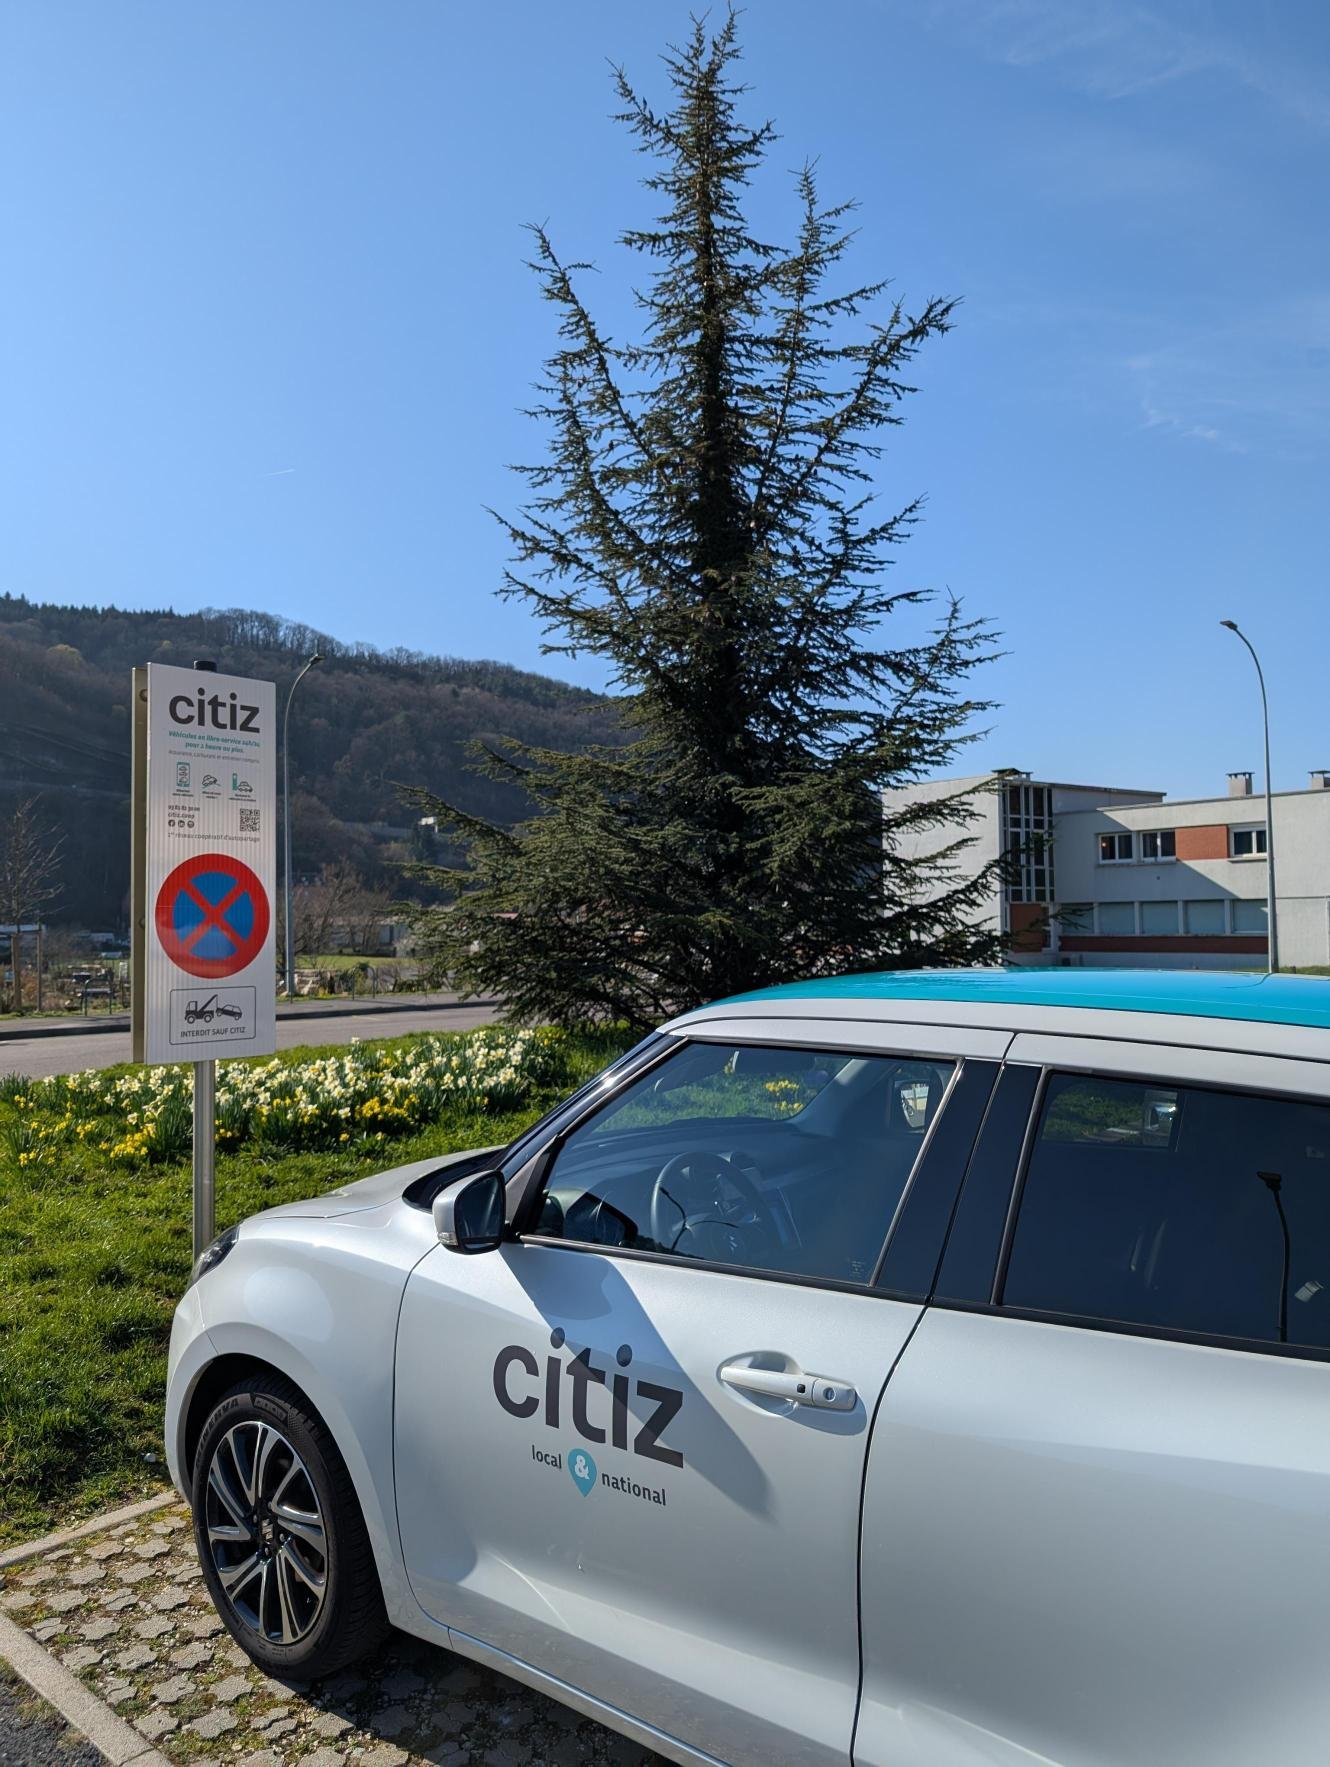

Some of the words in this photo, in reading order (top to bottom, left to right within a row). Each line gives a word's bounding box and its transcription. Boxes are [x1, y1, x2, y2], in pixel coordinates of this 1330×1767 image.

[169, 687, 260, 733] citiz
[180, 1028, 210, 1038] INTERDIT
[212, 1028, 228, 1036] SAUF
[493, 1326, 684, 1469] citiz
[532, 1444, 562, 1470] local
[574, 1454, 590, 1480] &
[601, 1472, 667, 1506] national
